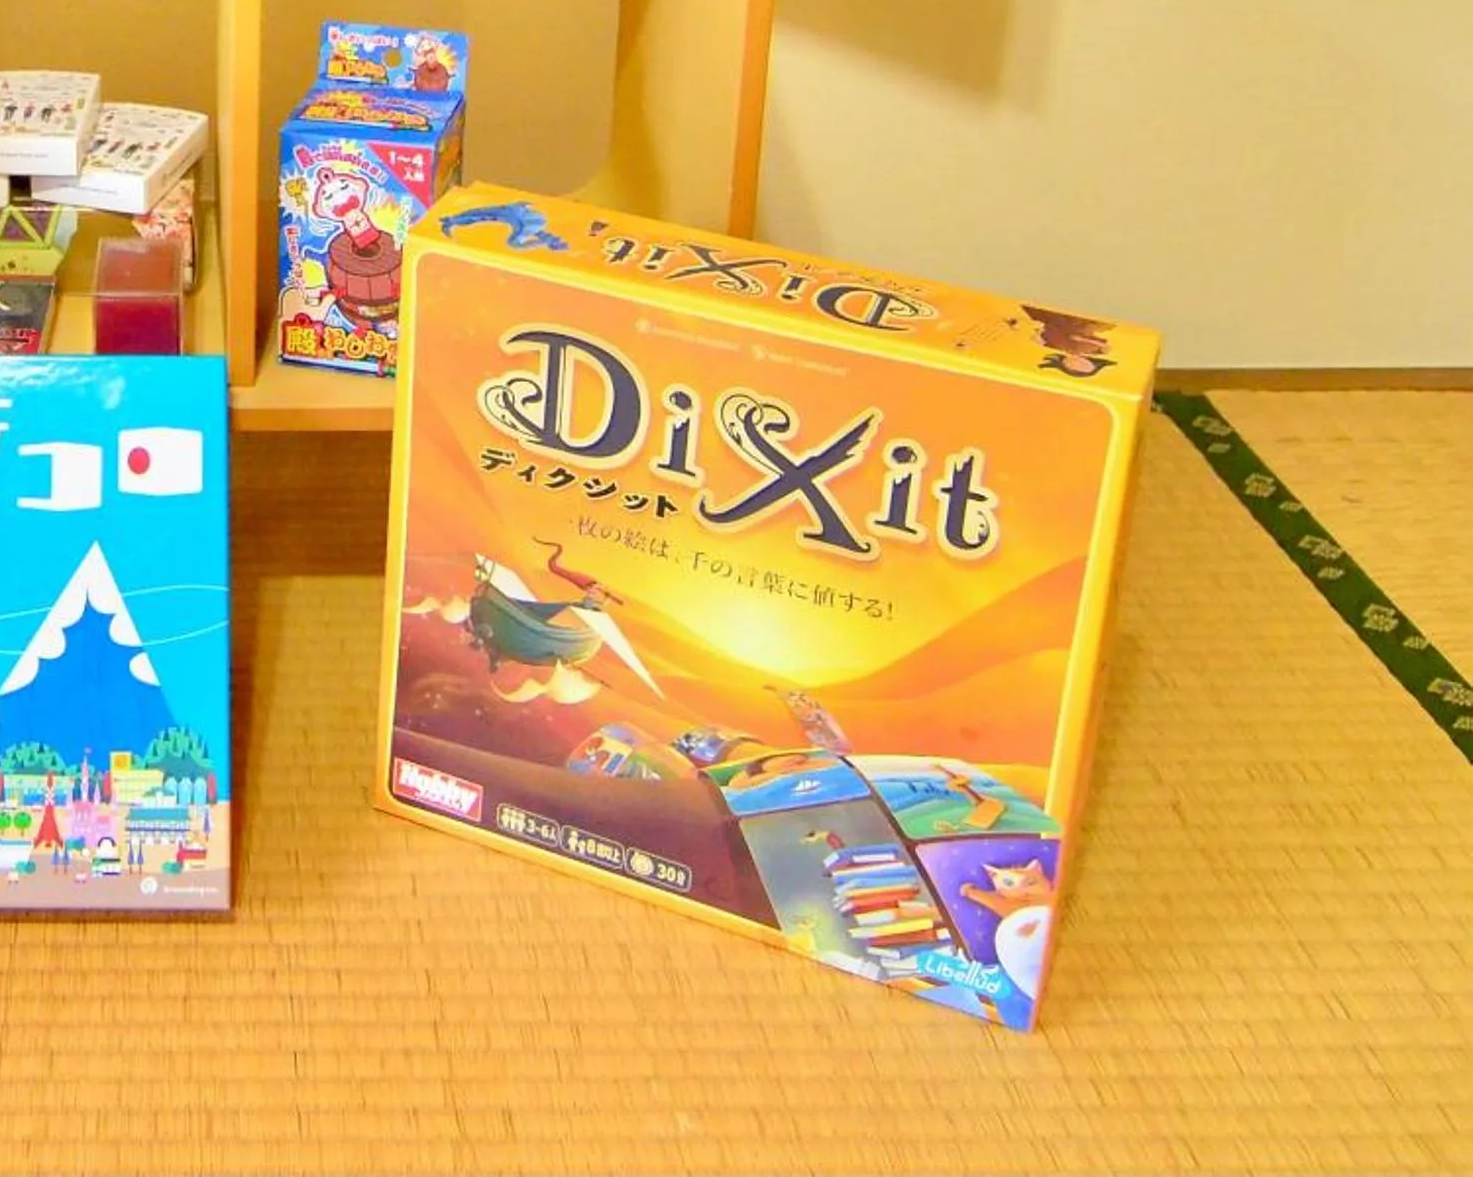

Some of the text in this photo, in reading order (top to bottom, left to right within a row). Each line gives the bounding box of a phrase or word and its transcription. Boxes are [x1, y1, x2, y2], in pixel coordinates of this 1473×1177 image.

[478, 448, 681, 520] ディクシット
[567, 514, 896, 623] 枚の絵は、千の言葉に値する!
[924, 952, 1004, 996] Libellud
